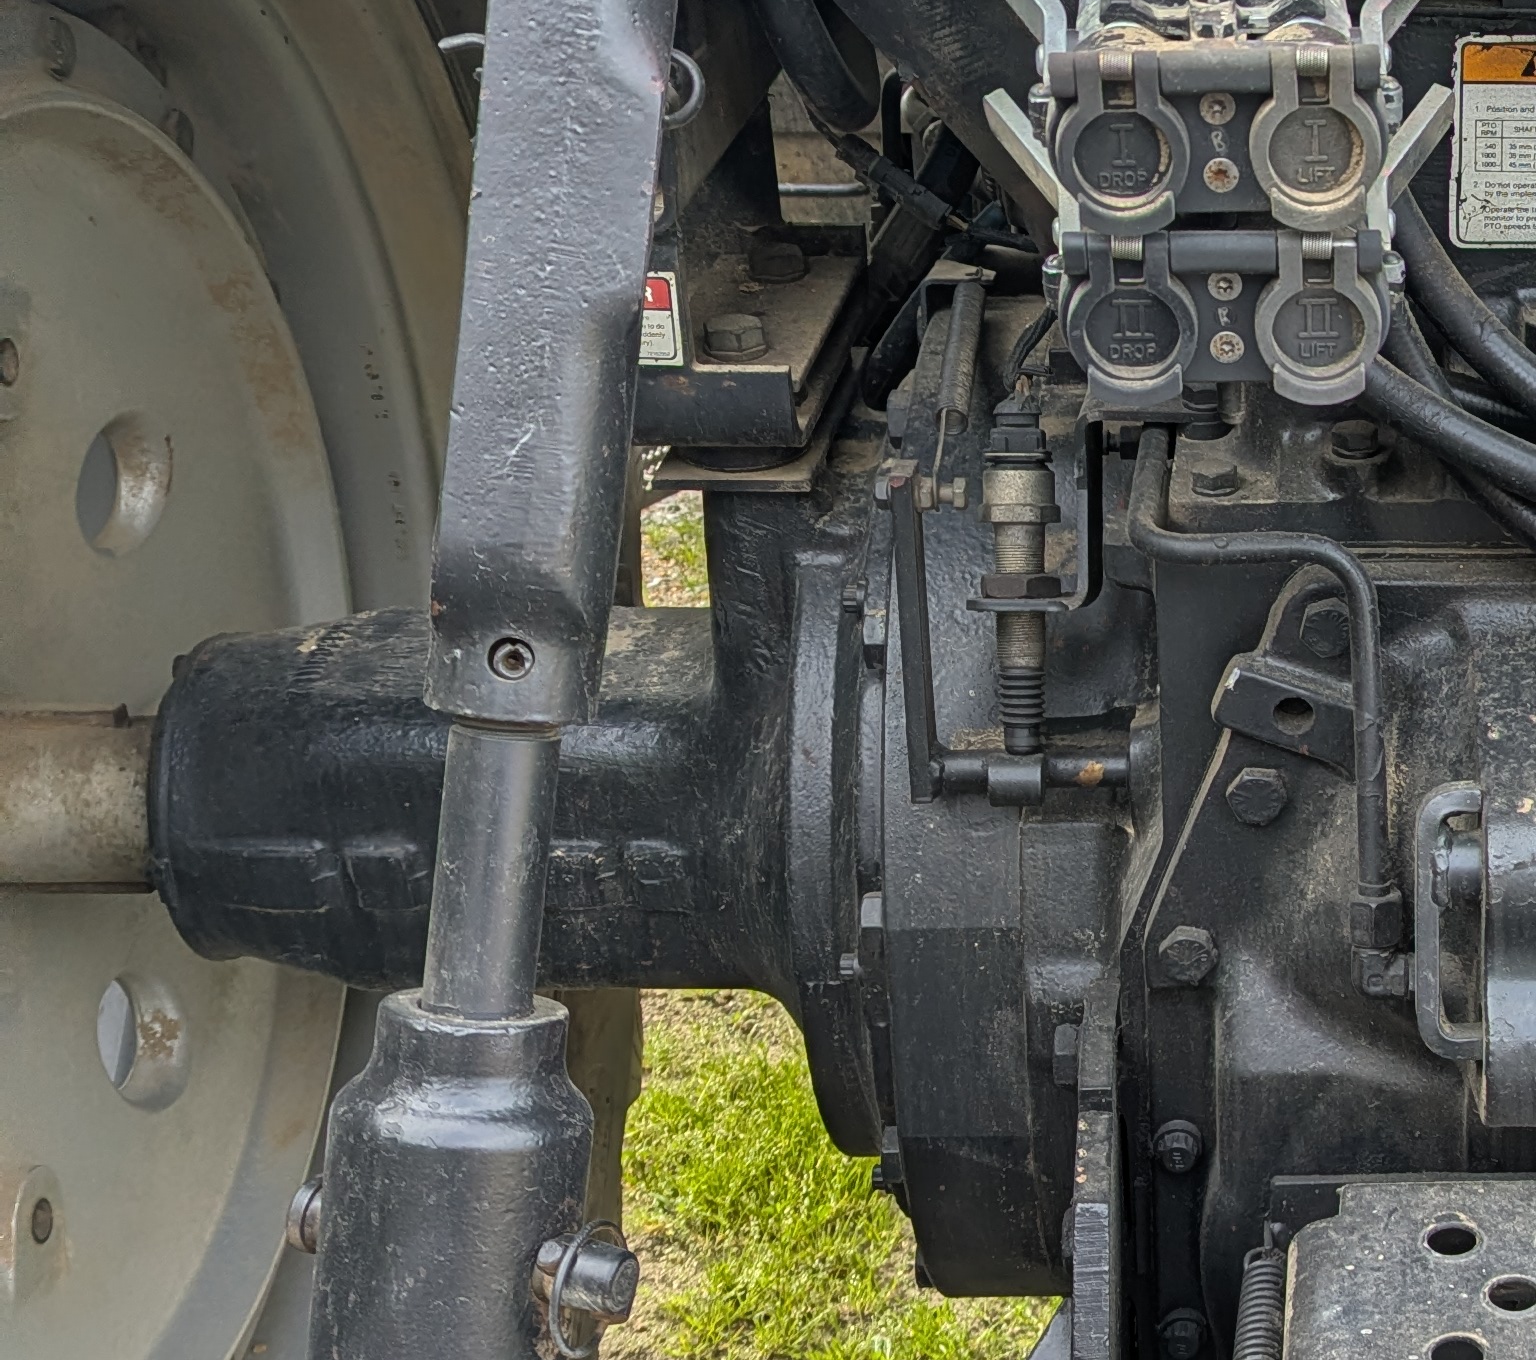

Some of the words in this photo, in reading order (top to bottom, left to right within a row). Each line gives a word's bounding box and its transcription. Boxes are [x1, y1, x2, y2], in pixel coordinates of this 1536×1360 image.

[1519, 105, 1536, 113] and
[1096, 169, 1150, 189] DROP
[1296, 165, 1338, 186] LIFT
[1484, 190, 1494, 198] by
[1483, 222, 1502, 230] PTO
[1108, 341, 1158, 360] DROP
[1297, 341, 1338, 360] LIFT
